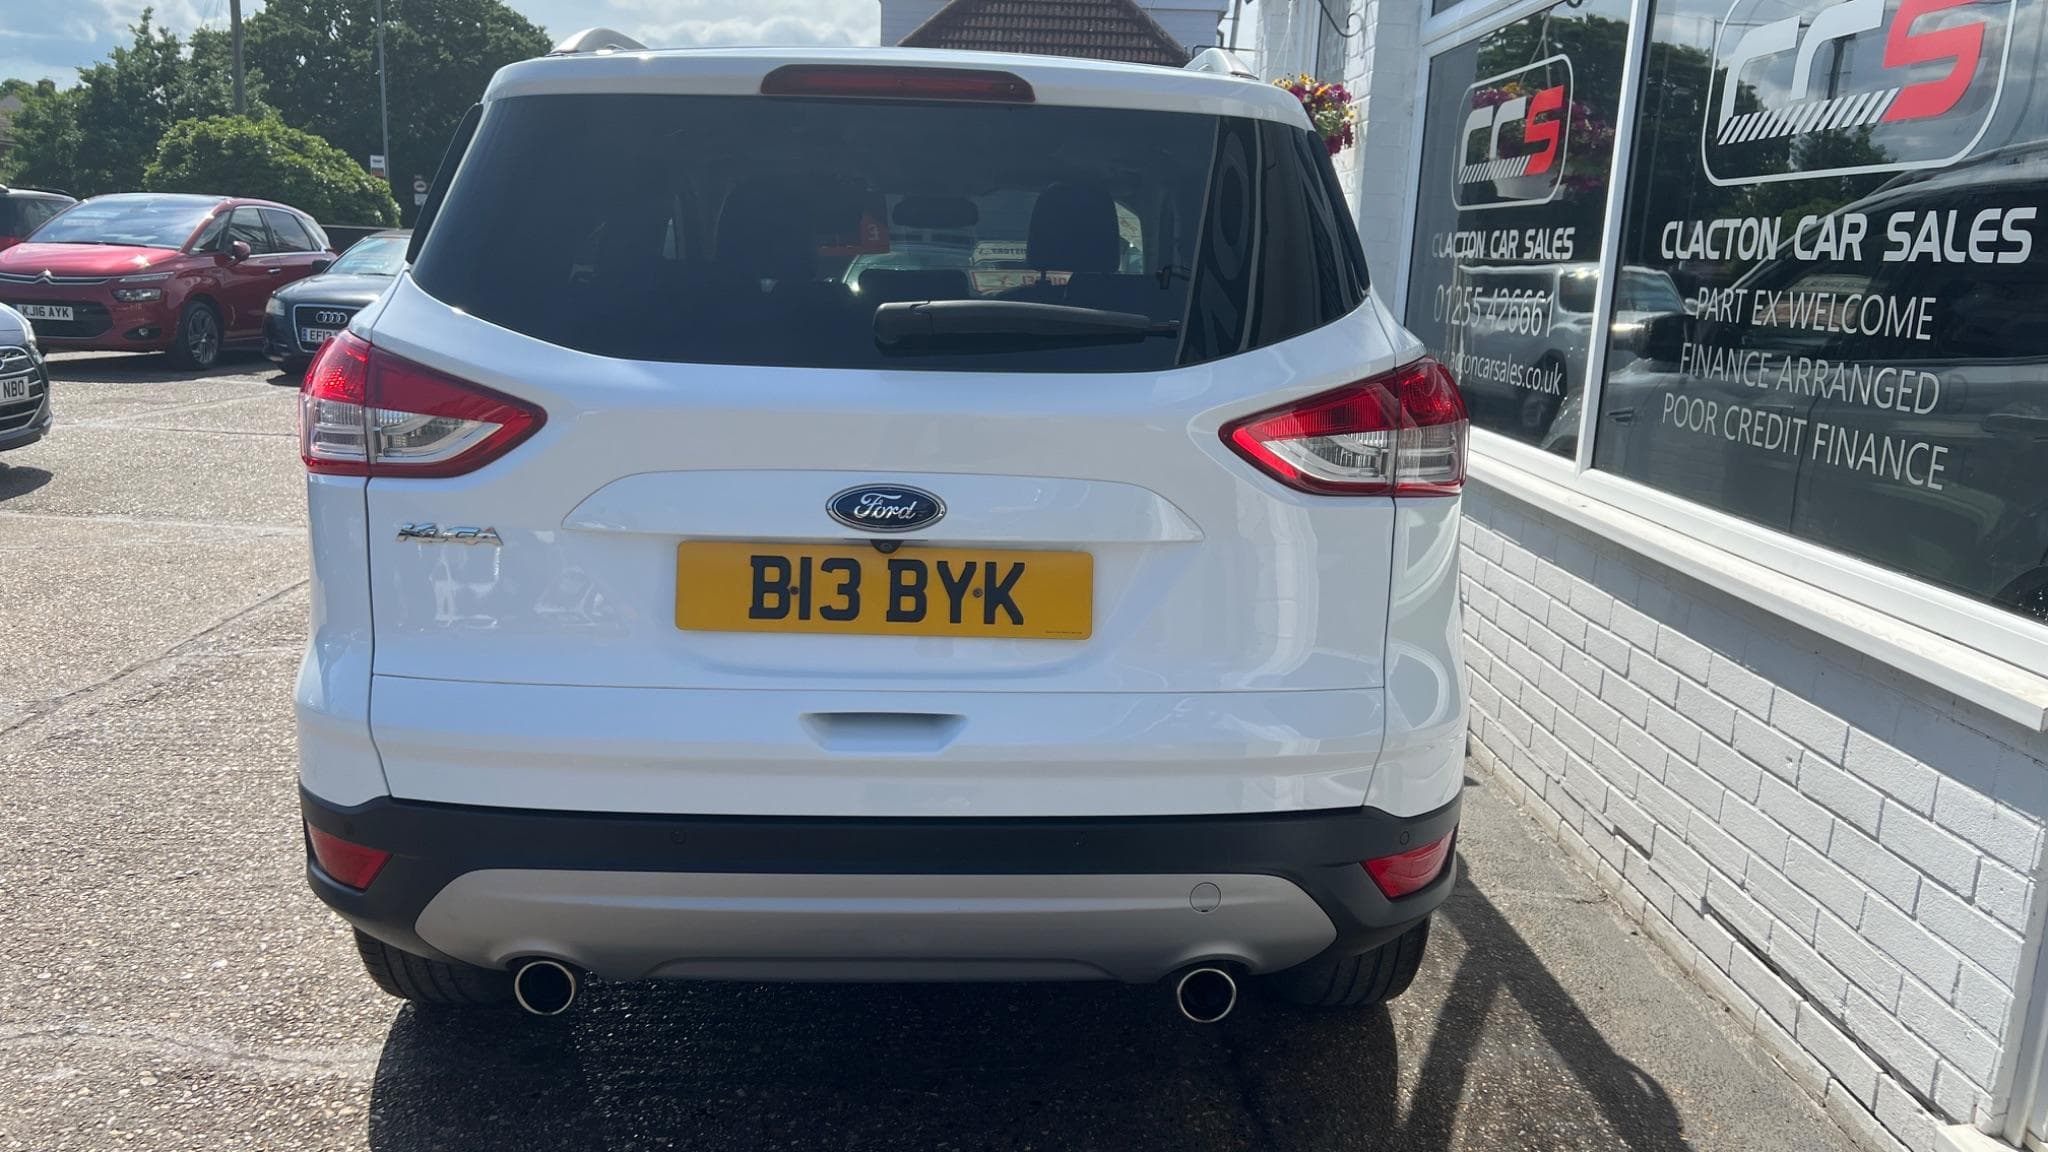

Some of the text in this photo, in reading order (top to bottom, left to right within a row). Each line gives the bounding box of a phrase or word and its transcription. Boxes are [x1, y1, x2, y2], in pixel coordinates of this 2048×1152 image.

[1458, 84, 1565, 184] CCS
[1432, 227, 1576, 260] CLACTON CAR SALES
[1661, 207, 2038, 264] CLACTON CAR SALES
[22, 305, 70, 318] KJ16 AYK
[1434, 284, 1555, 338] 01255 426661
[1695, 286, 1937, 341] PART EX WELCOME
[2, 380, 25, 399] NBO
[1679, 342, 1942, 415] FINANCE ARRANGED
[1662, 392, 1949, 491] POOR CREDIT FINANCE
[854, 492, 918, 519] Ford
[749, 555, 1026, 626] B13 BYK
